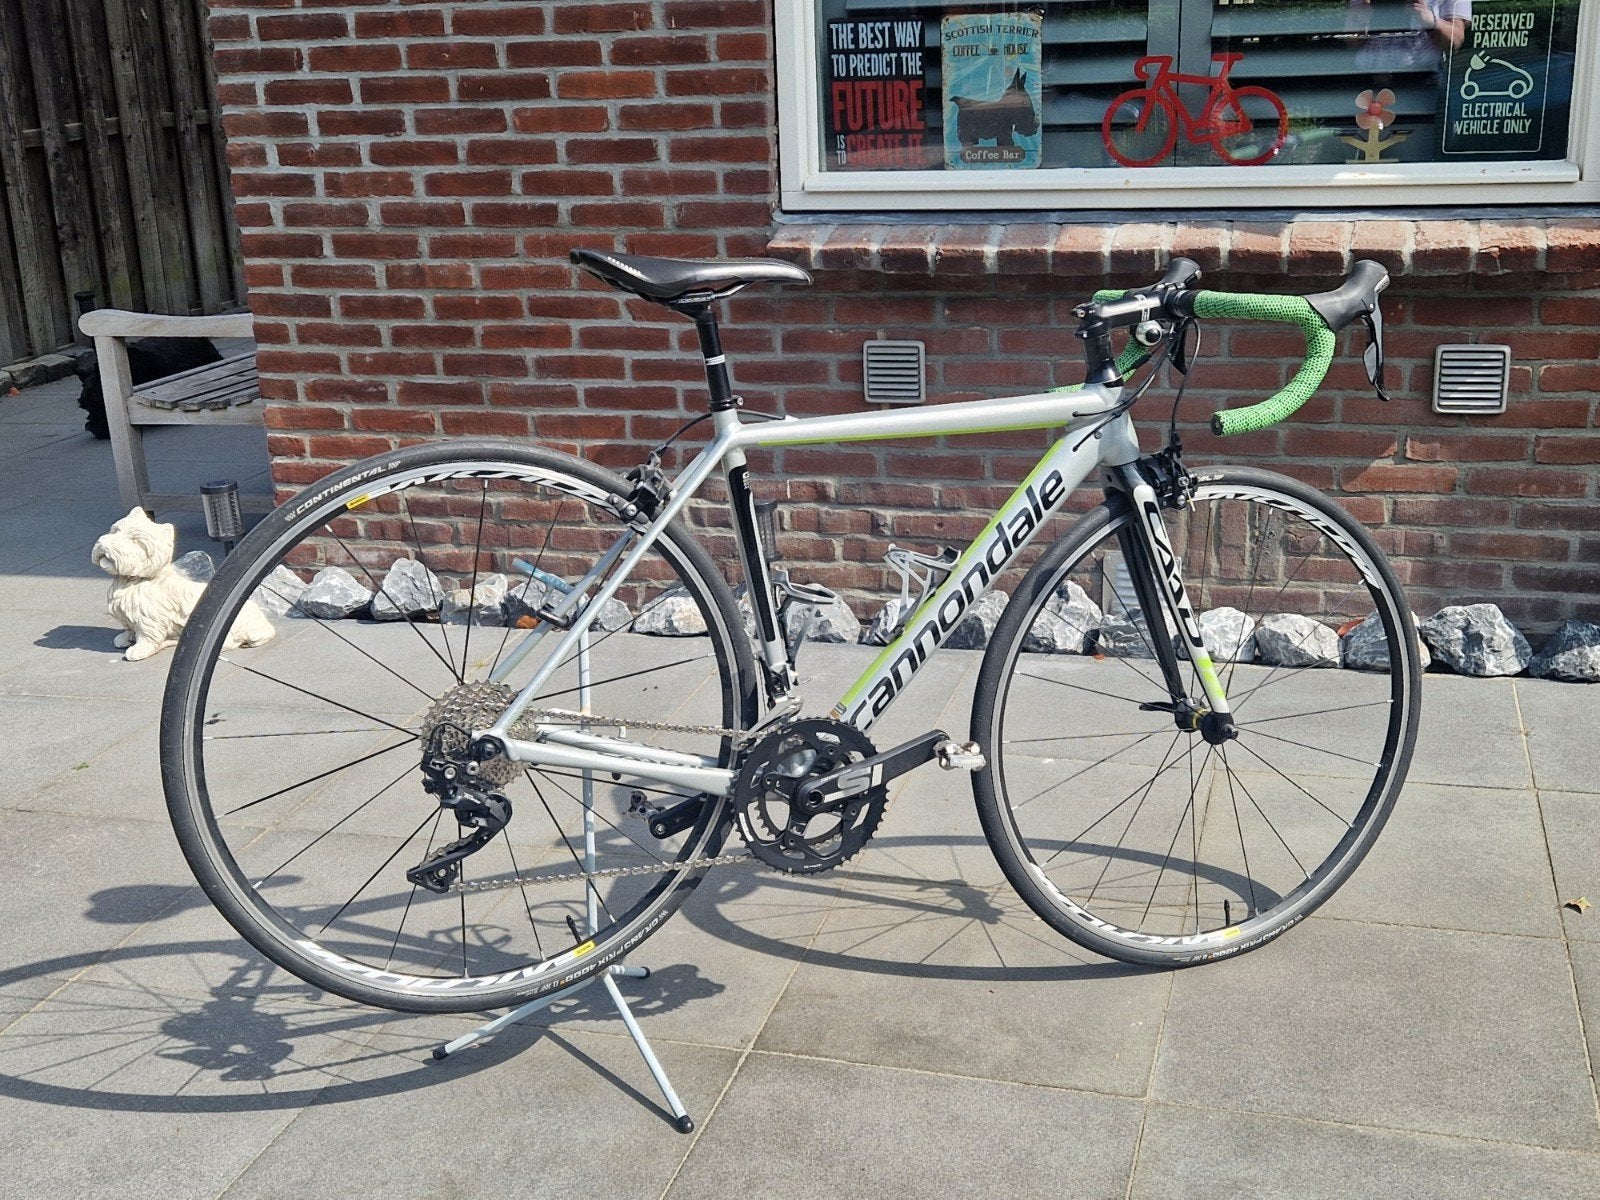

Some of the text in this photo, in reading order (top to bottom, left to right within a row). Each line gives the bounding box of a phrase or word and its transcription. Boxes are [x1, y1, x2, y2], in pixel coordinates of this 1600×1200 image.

[1471, 12, 1535, 31] RESERVED
[830, 21, 922, 49] THE BEST WAY
[945, 24, 1039, 41] SCOTTISH TERRIER
[1473, 30, 1529, 48] PARKING
[953, 43, 1029, 57] COFFEE HOUSE
[832, 52, 923, 77] TO PREDICT THE
[832, 81, 925, 132] FUTURE
[1461, 102, 1527, 118] ELECTRICAL
[1455, 119, 1532, 135] VEHICLE ONLY
[837, 135, 846, 149] IS
[836, 151, 847, 165] TO
[965, 150, 1020, 160] Coffee Bar
[295, 465, 387, 516] CONTINENTAL
[849, 468, 1066, 731] cannondale
[624, 917, 659, 949] GRAND
[597, 944, 623, 966] PRIX
